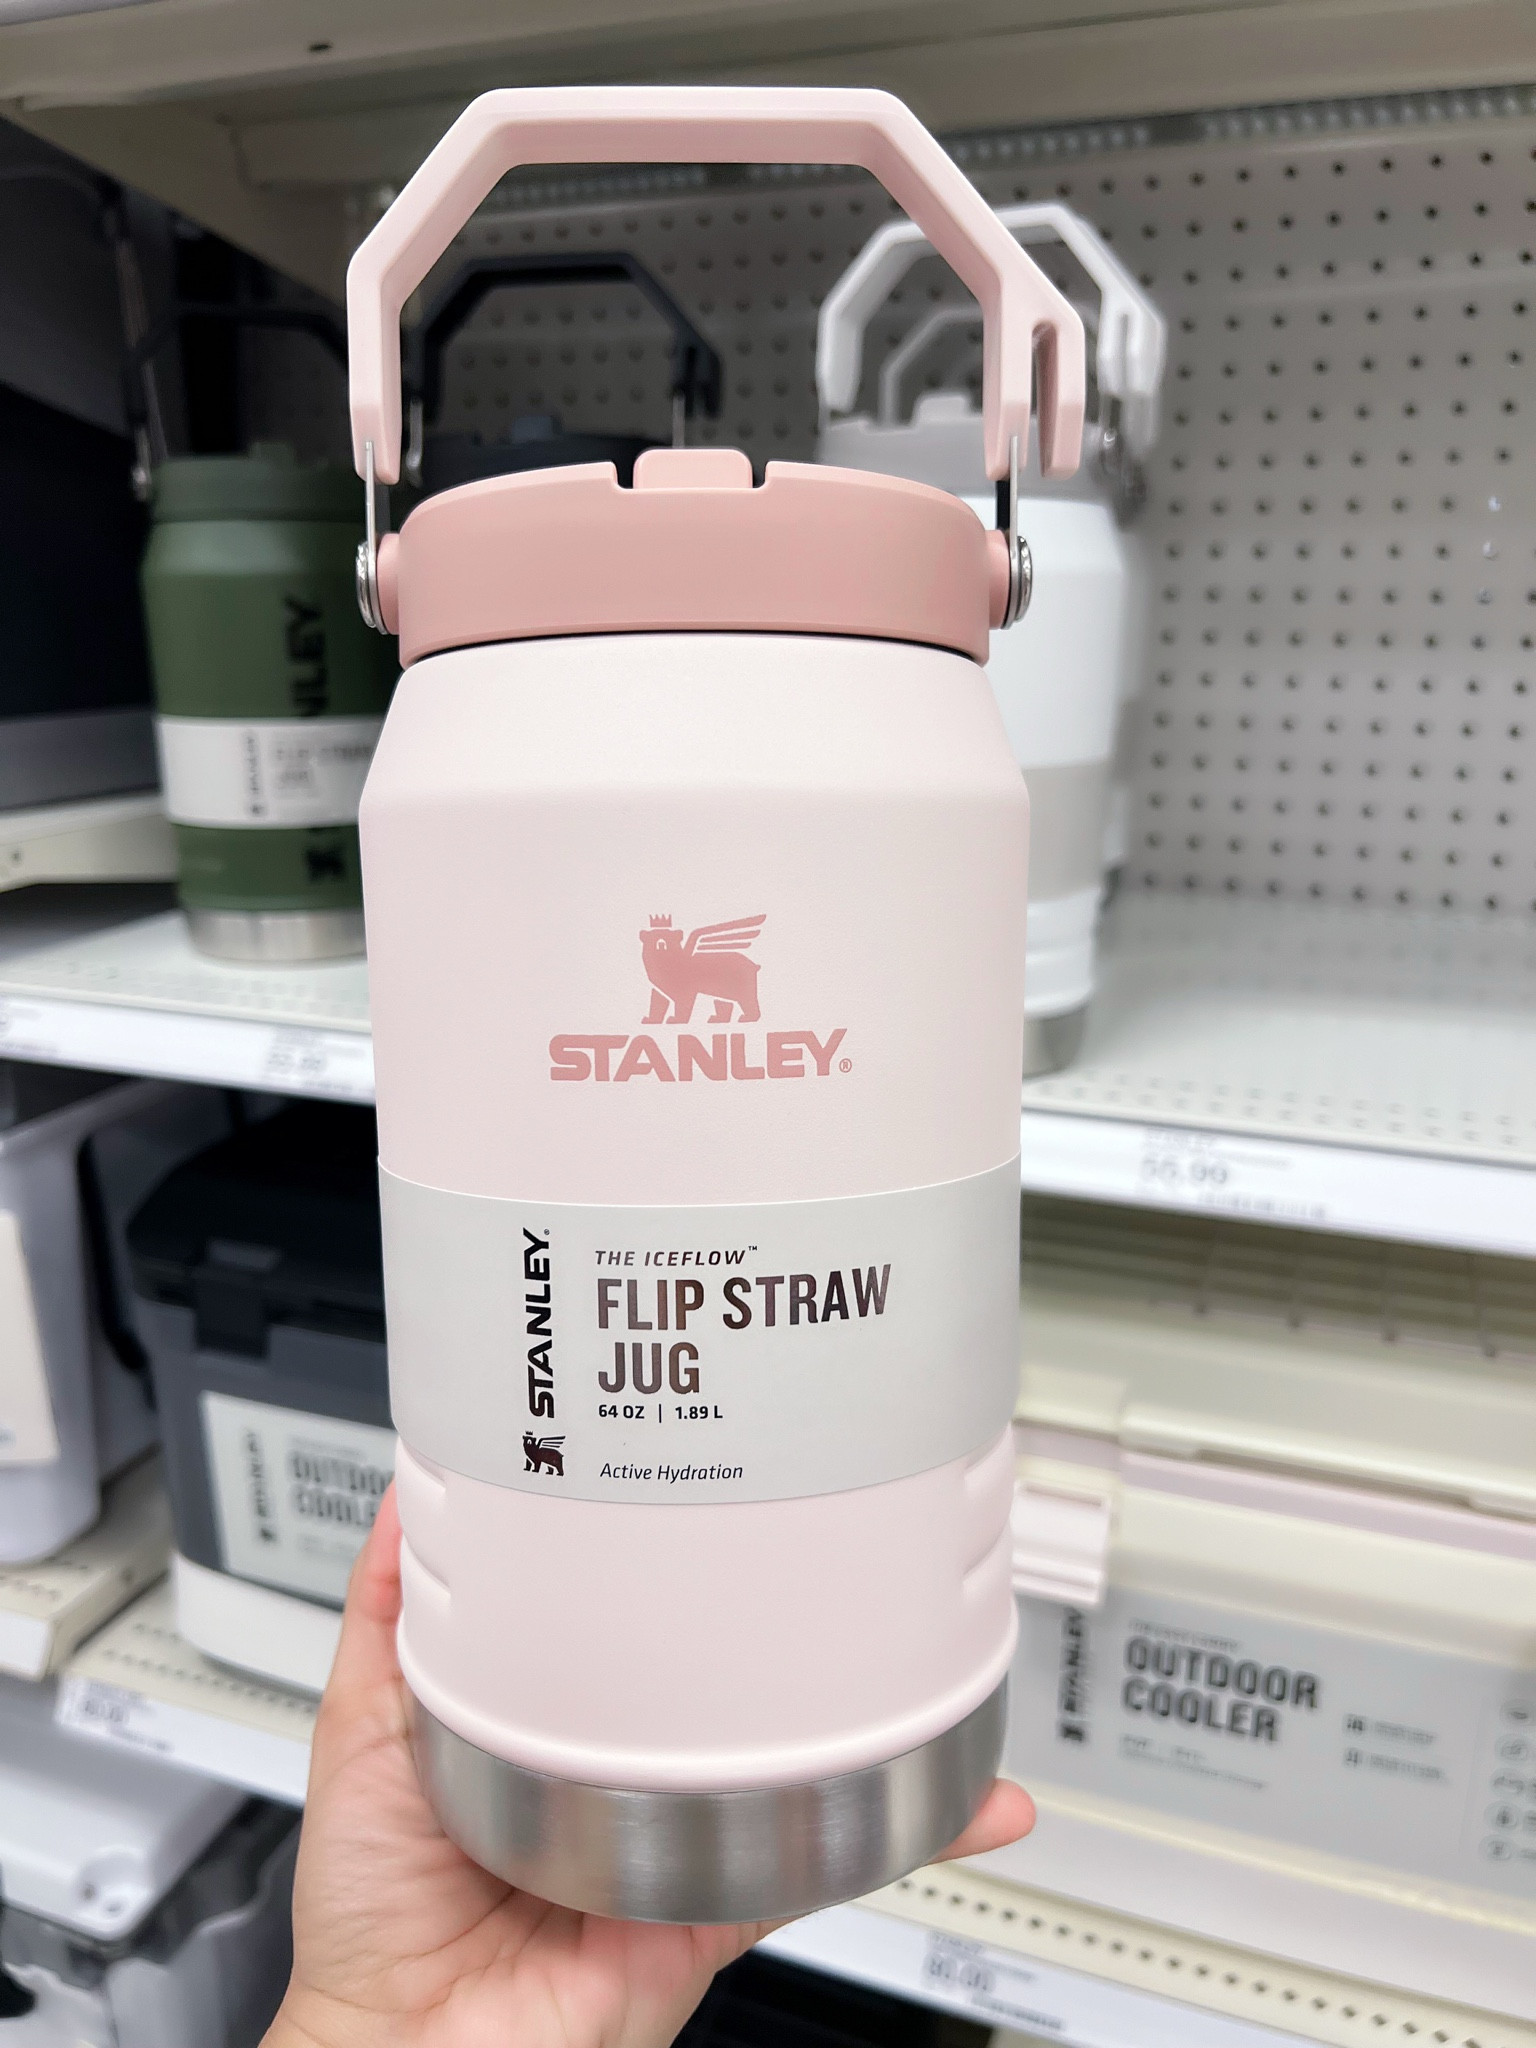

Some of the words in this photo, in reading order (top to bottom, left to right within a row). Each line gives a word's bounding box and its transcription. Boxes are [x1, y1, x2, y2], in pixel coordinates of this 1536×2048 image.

[596, 1251, 635, 1266] THE
[598, 1279, 704, 1330] FLIP
[723, 1262, 892, 1330] STRAW
[598, 1342, 699, 1394] JUG
[599, 1405, 618, 1418] 64
[623, 1405, 644, 1419] OZ
[675, 1406, 708, 1419] 1.89
[714, 1405, 723, 1418] L
[600, 1463, 652, 1479] Active
[658, 1464, 742, 1484] Hydration
[1125, 1636, 1319, 1709] OUTDOOR
[1122, 1677, 1278, 1742] COOLER
